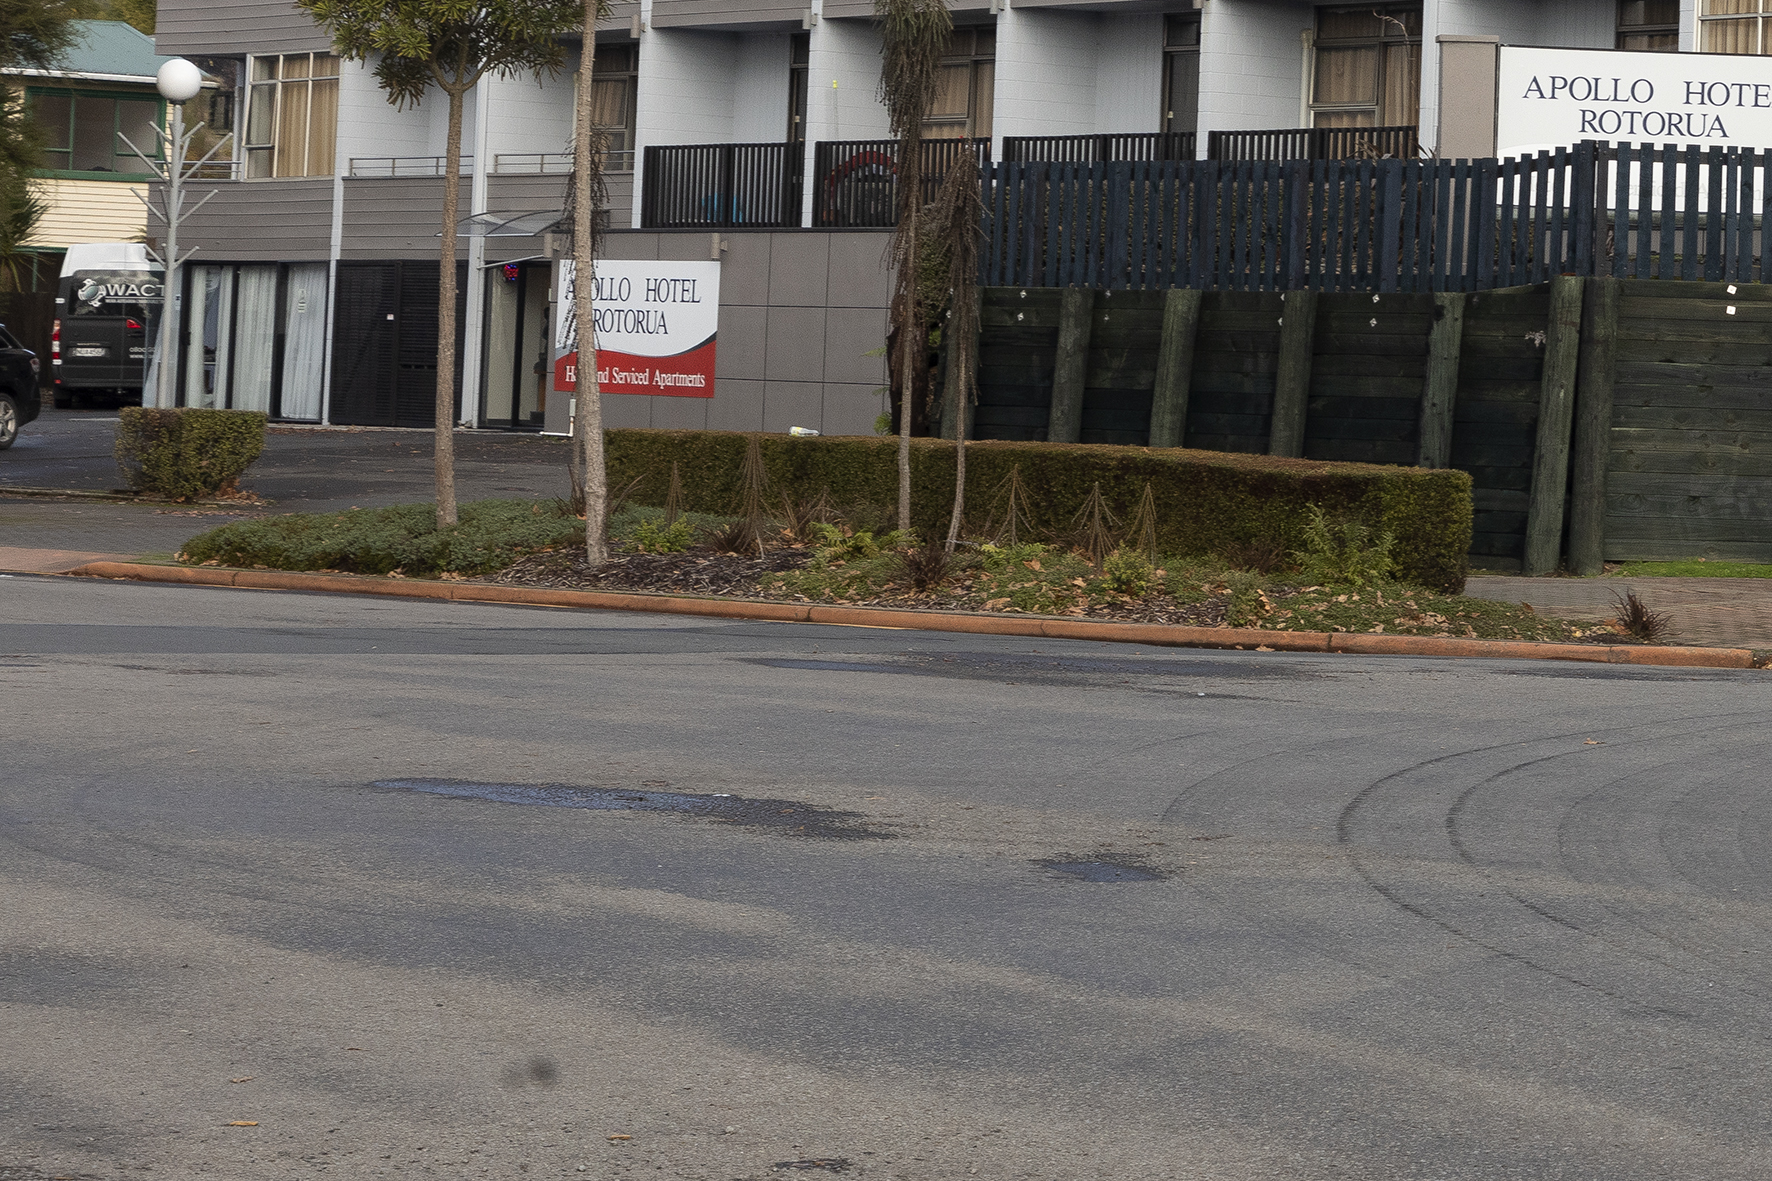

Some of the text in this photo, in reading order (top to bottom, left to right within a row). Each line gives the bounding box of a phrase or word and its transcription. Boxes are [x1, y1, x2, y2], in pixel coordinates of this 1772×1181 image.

[1522, 75, 1654, 104] APOLLO
[1578, 109, 1730, 138] ROTORUA
[565, 276, 702, 304] AOLLO HOTEL
[592, 308, 669, 334] ROTORUA
[596, 367, 609, 383] nd
[612, 367, 649, 385] Serviced
[652, 369, 706, 389] Apartments
